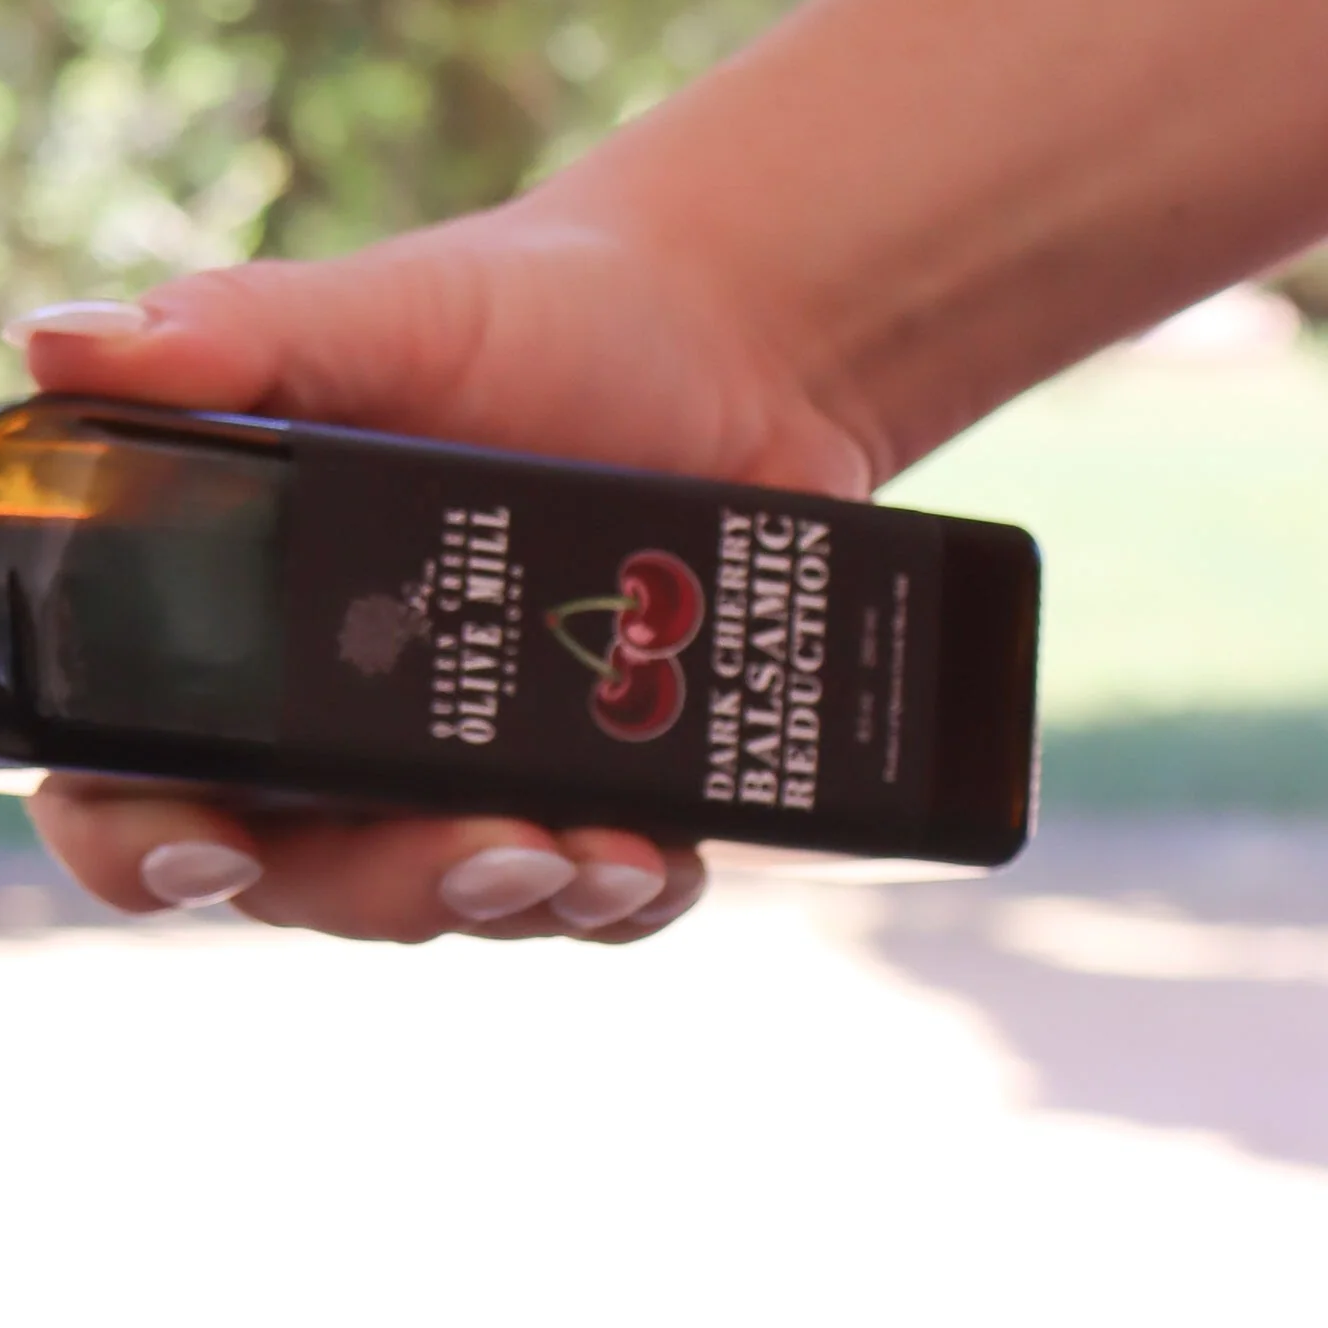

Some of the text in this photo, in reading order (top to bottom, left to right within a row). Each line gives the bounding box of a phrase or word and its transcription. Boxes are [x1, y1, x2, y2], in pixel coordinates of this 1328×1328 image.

[456, 506, 511, 745] OLIVE MILL
[704, 507, 752, 801] DARK CHERRY
[739, 512, 794, 804] BALSAMIC
[780, 520, 830, 813] REDUCTION
